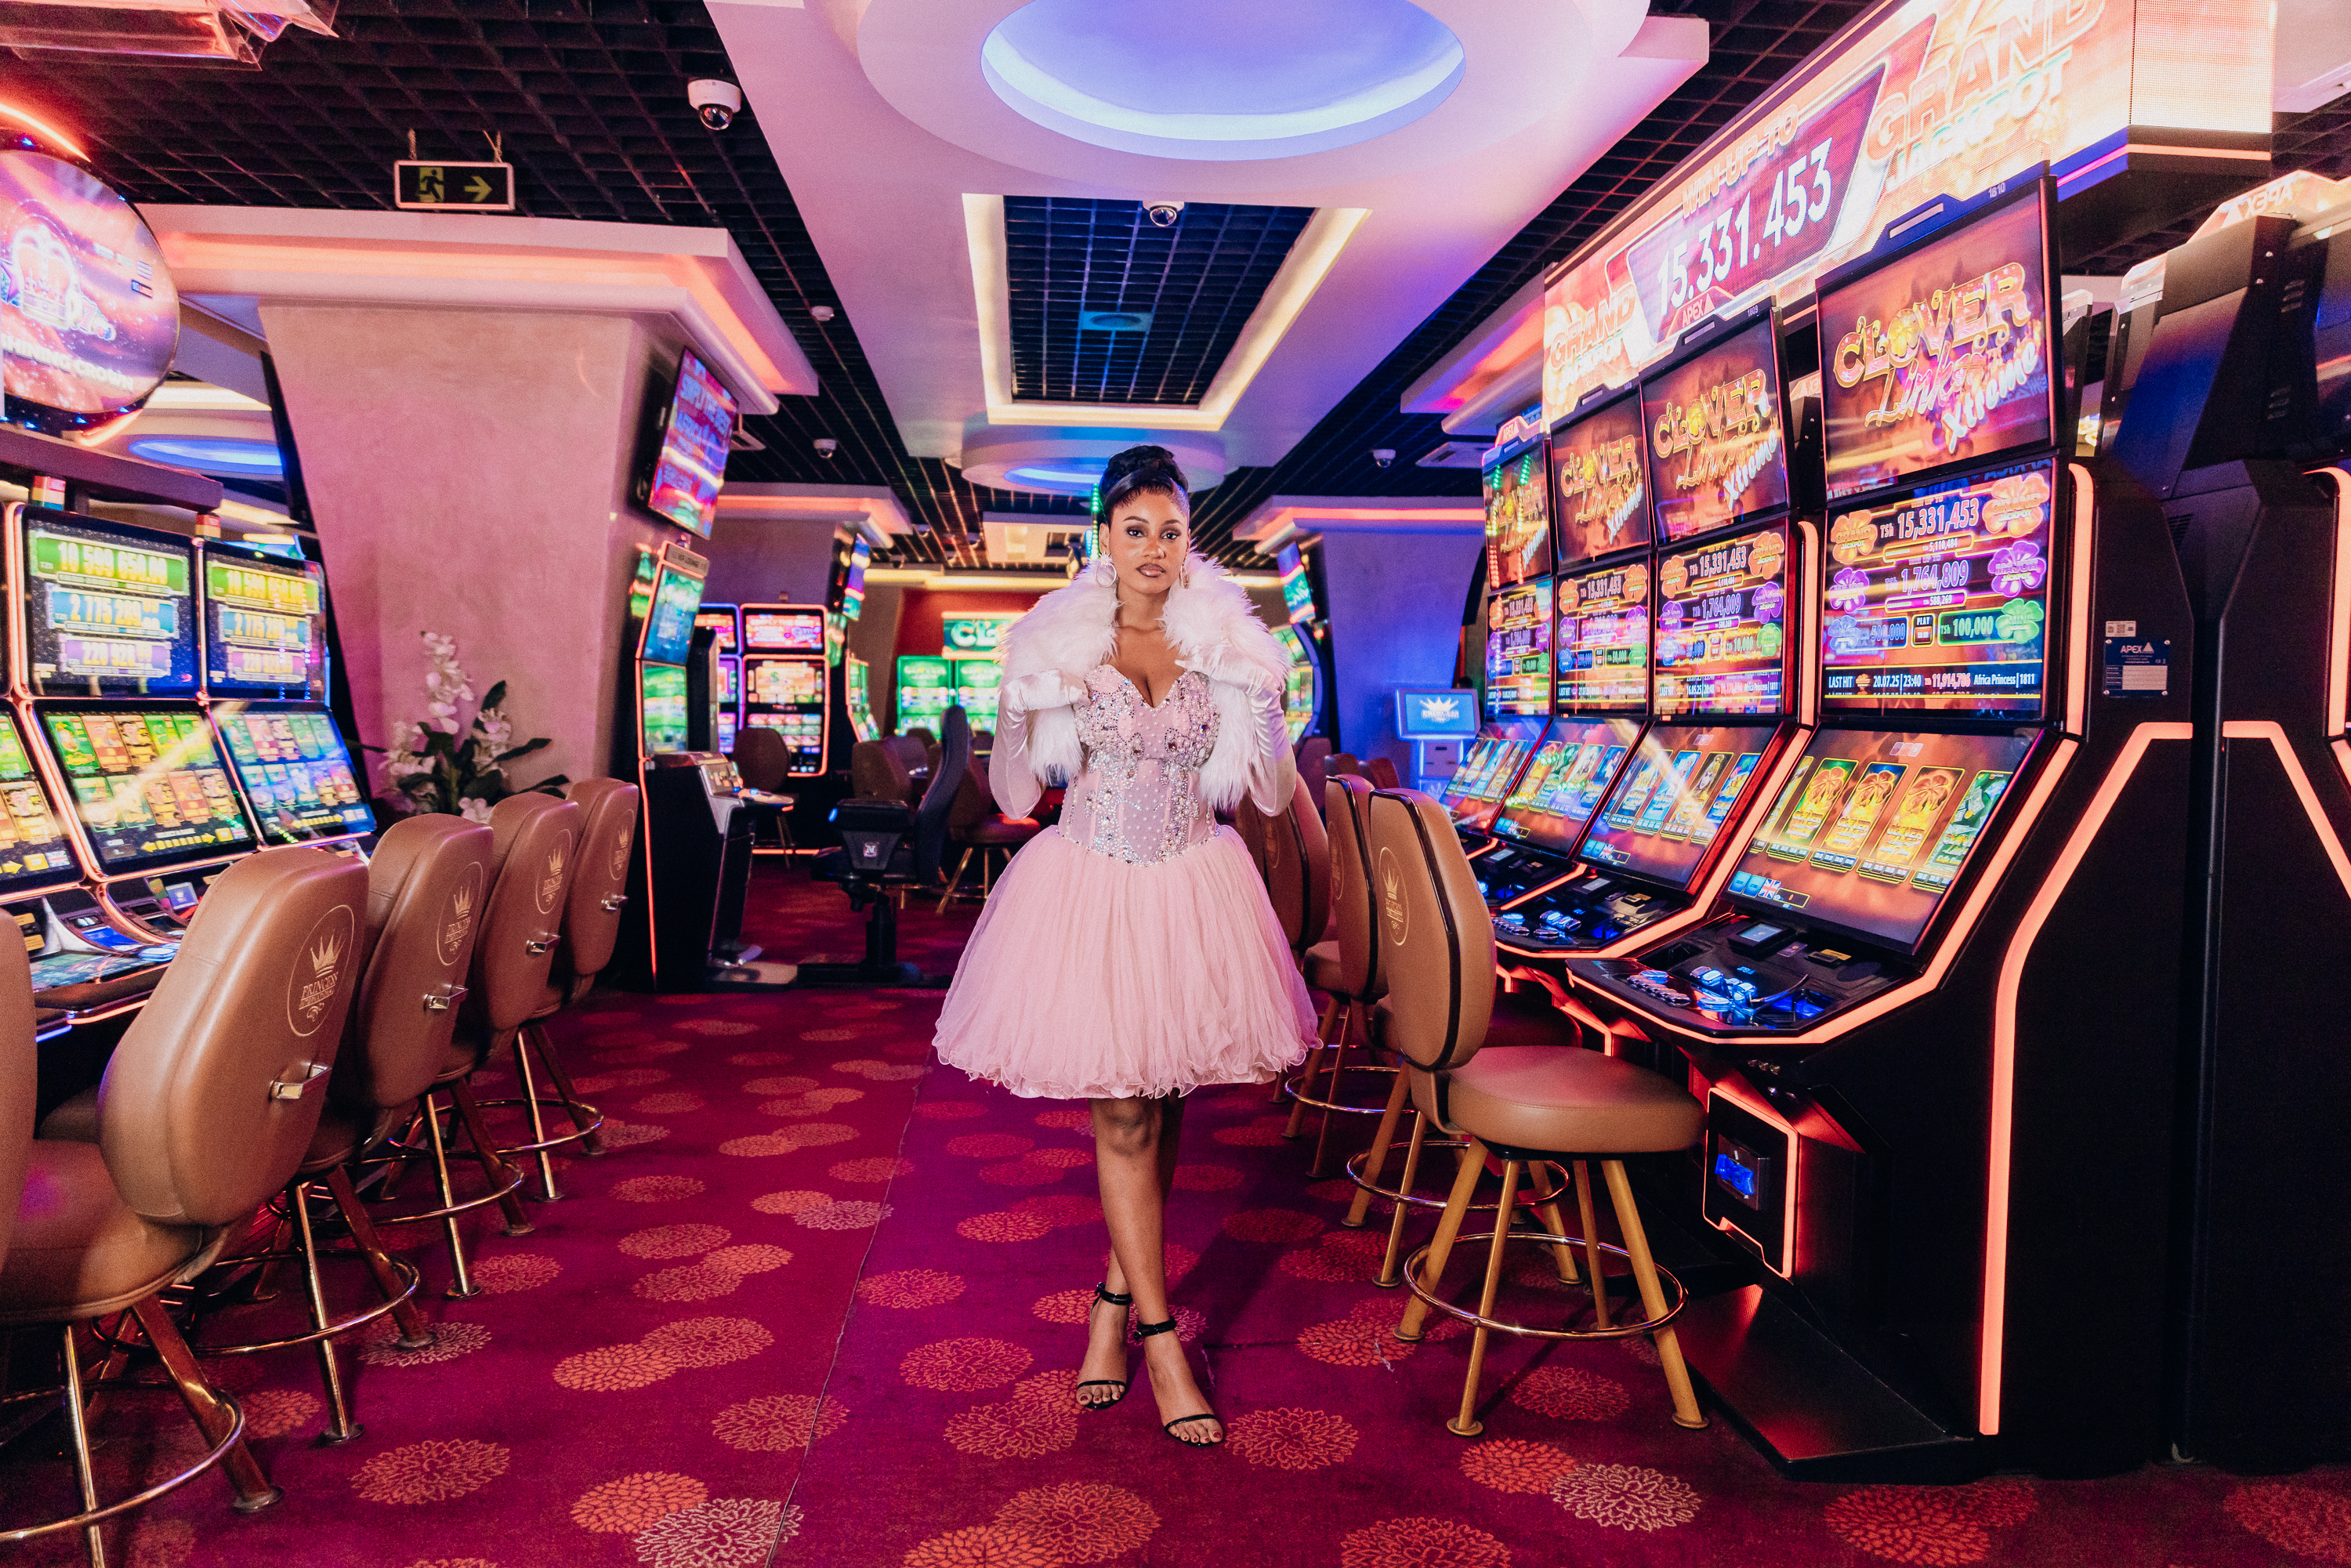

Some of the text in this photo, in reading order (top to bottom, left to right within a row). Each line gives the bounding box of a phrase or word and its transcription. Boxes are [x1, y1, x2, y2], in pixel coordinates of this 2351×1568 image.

[1682, 103, 1799, 219] WIN UP TO
[1656, 136, 1832, 317] 15.331.453
[1550, 280, 1636, 371] GRAND
[1683, 302, 1704, 328] APEX
[1834, 262, 2031, 389] CLOVER
[1941, 342, 2039, 454] Xtreme
[1654, 368, 1771, 458] CLOVER
[1560, 434, 1638, 498] CLOVER
[1723, 429, 1777, 511] Xtreme
[1991, 493, 2041, 516] GRAND
[1998, 509, 2032, 523] JACKPOT
[1881, 498, 1980, 541] TSh 15,331,453
[1835, 527, 1871, 544] GRAND
[1841, 540, 1865, 550] JACKPOT
[59, 541, 79, 573] 10
[1700, 546, 1747, 578] 15,331,453
[1995, 559, 2039, 576] MAJOR
[1588, 575, 1621, 601] 15,331,453
[1901, 559, 1970, 596] 1,764,809
[2001, 571, 2032, 582] JACKPOT
[70, 593, 82, 621] 2
[1702, 593, 1742, 621] 1,764,809
[1917, 616, 1930, 626] PLAY
[1953, 615, 1994, 639] 100,000
[2120, 645, 2143, 654] APEX
[1828, 675, 1842, 689] LAST
[1843, 675, 1853, 688] HIT
[1873, 675, 1900, 688] 20.07.25
[1903, 674, 1922, 687] 23:40
[1973, 675, 1991, 686] Africa
[1991, 675, 2016, 686] Princess
[2020, 673, 2035, 684] 1811
[302, 972, 339, 999] PRINCESS
